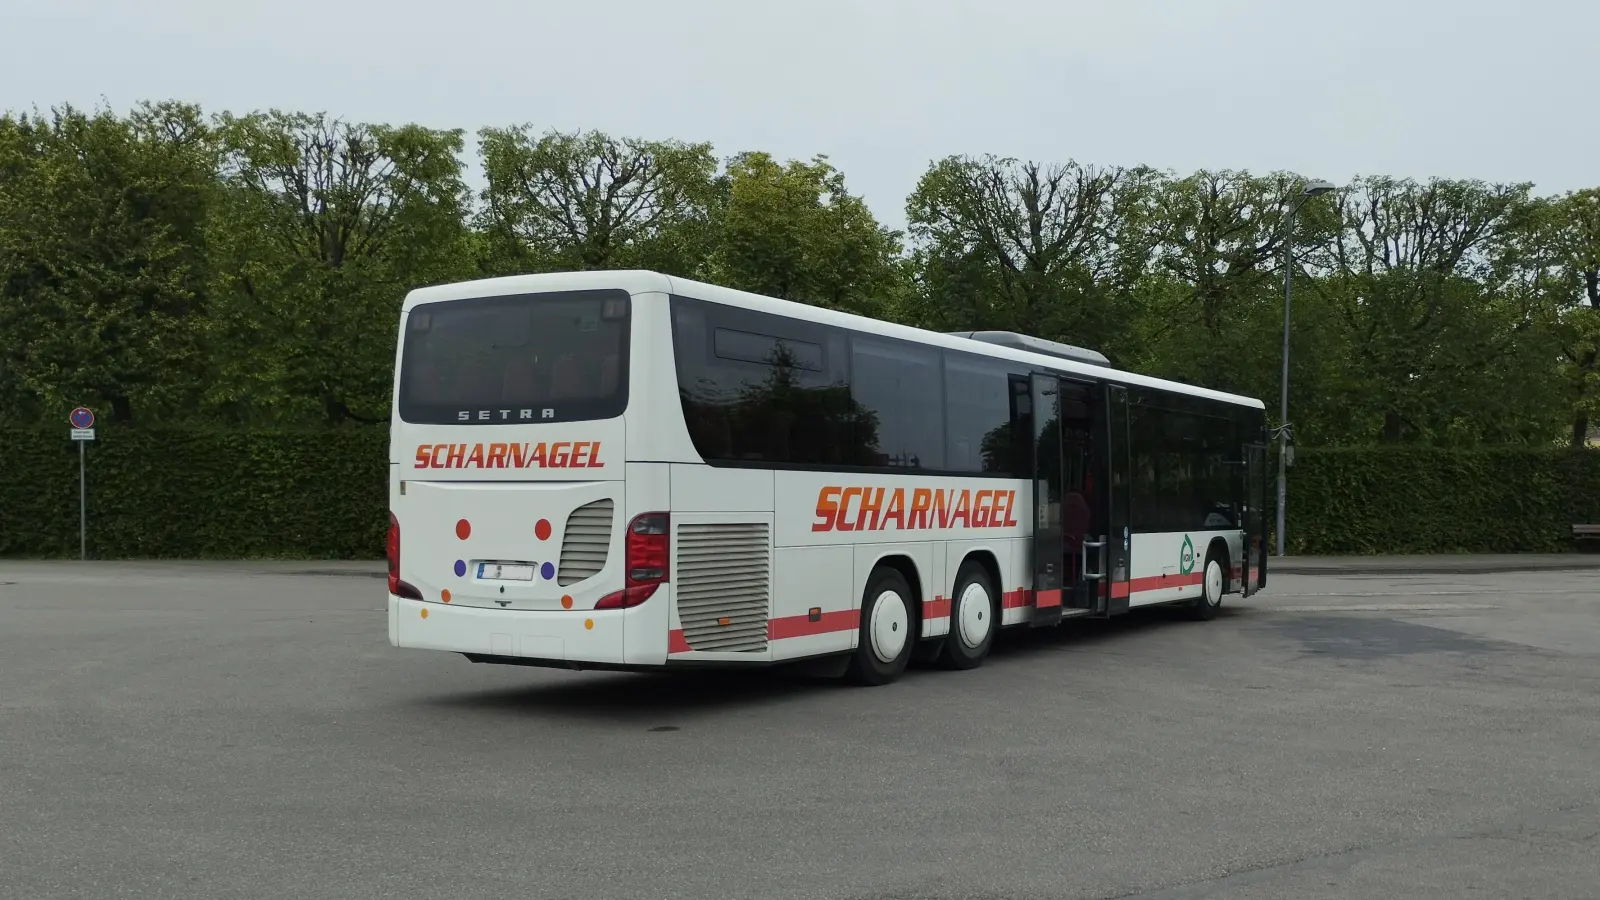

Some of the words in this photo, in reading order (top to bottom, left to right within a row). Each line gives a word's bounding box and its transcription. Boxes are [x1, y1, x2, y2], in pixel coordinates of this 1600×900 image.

[458, 408, 555, 421] SETRA
[414, 441, 605, 469] SCHARNAGEL
[811, 486, 1018, 533] SCHARNAGEL
